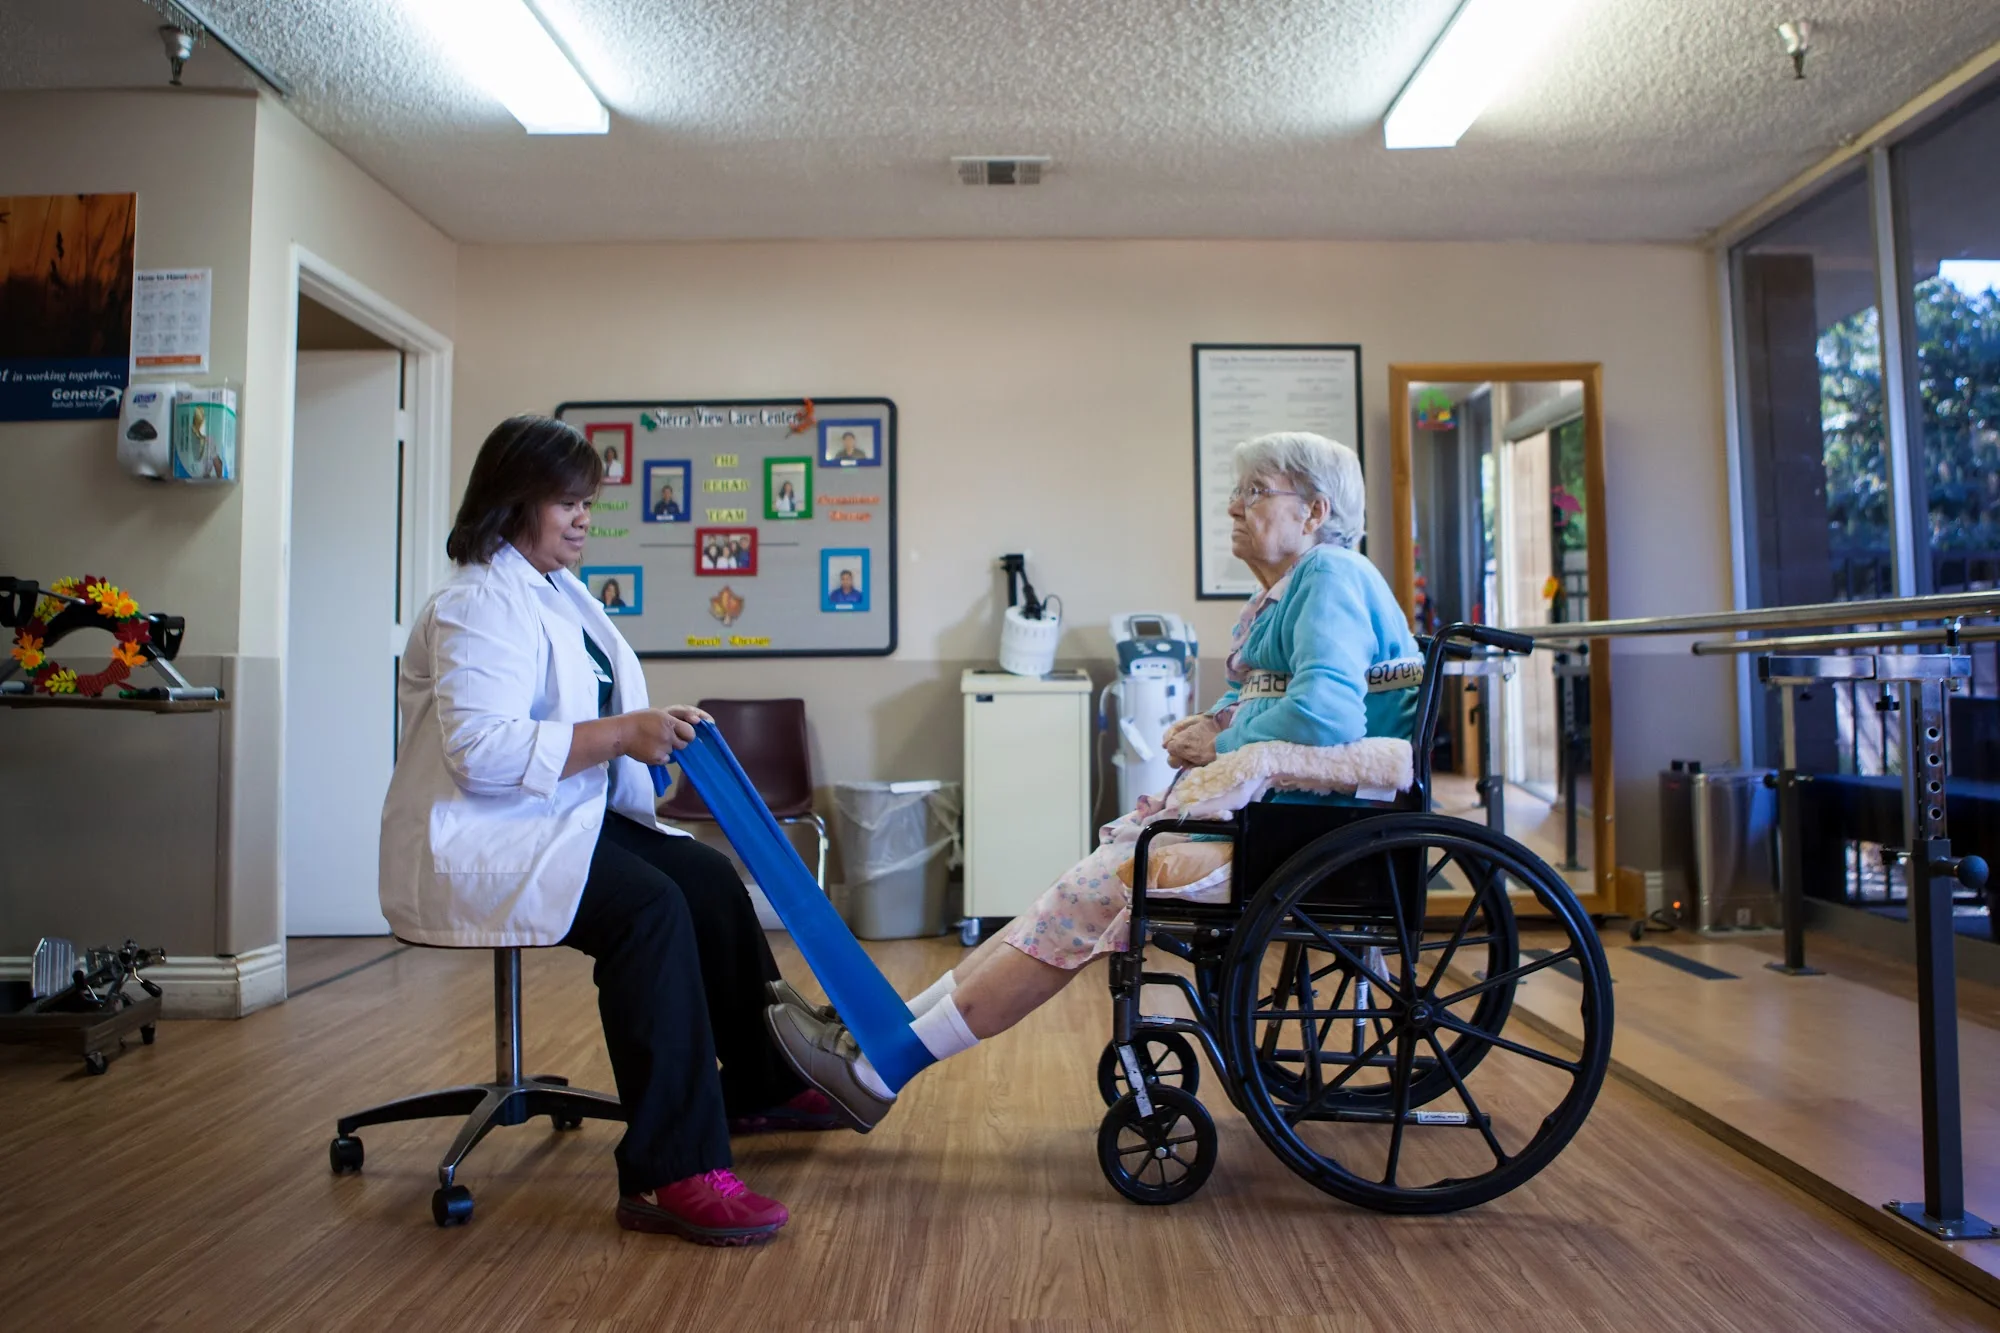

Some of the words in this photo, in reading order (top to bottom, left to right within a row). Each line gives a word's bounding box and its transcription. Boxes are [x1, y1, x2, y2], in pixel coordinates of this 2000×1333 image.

[12, 371, 23, 382] in
[26, 369, 66, 383] working
[52, 386, 107, 400] Genesis
[655, 408, 691, 426] Sierra
[694, 406, 724, 425] View
[728, 408, 755, 425] Care
[713, 454, 738, 467] THE
[706, 509, 746, 521] TEAM
